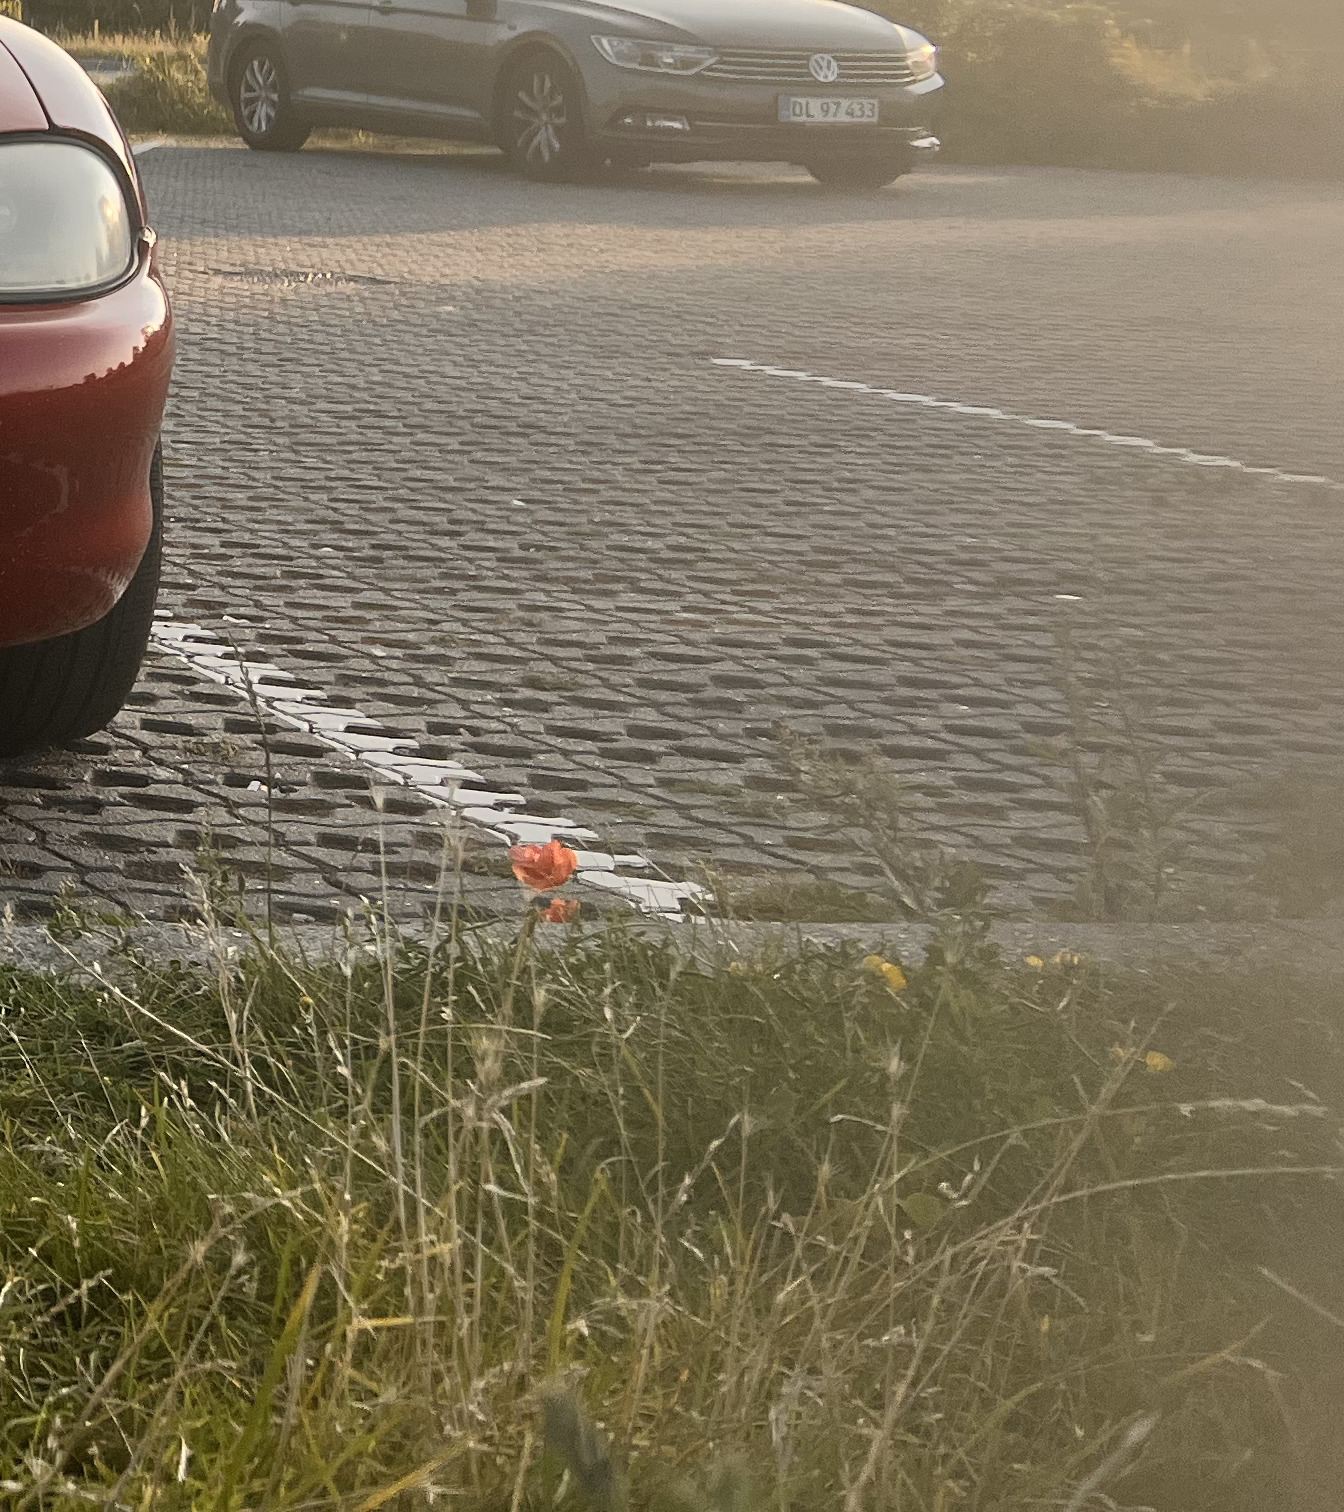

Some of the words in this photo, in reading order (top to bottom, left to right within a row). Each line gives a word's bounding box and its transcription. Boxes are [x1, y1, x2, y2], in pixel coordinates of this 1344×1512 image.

[792, 100, 815, 118] DL
[820, 100, 841, 118] 97
[845, 100, 876, 119] 433
